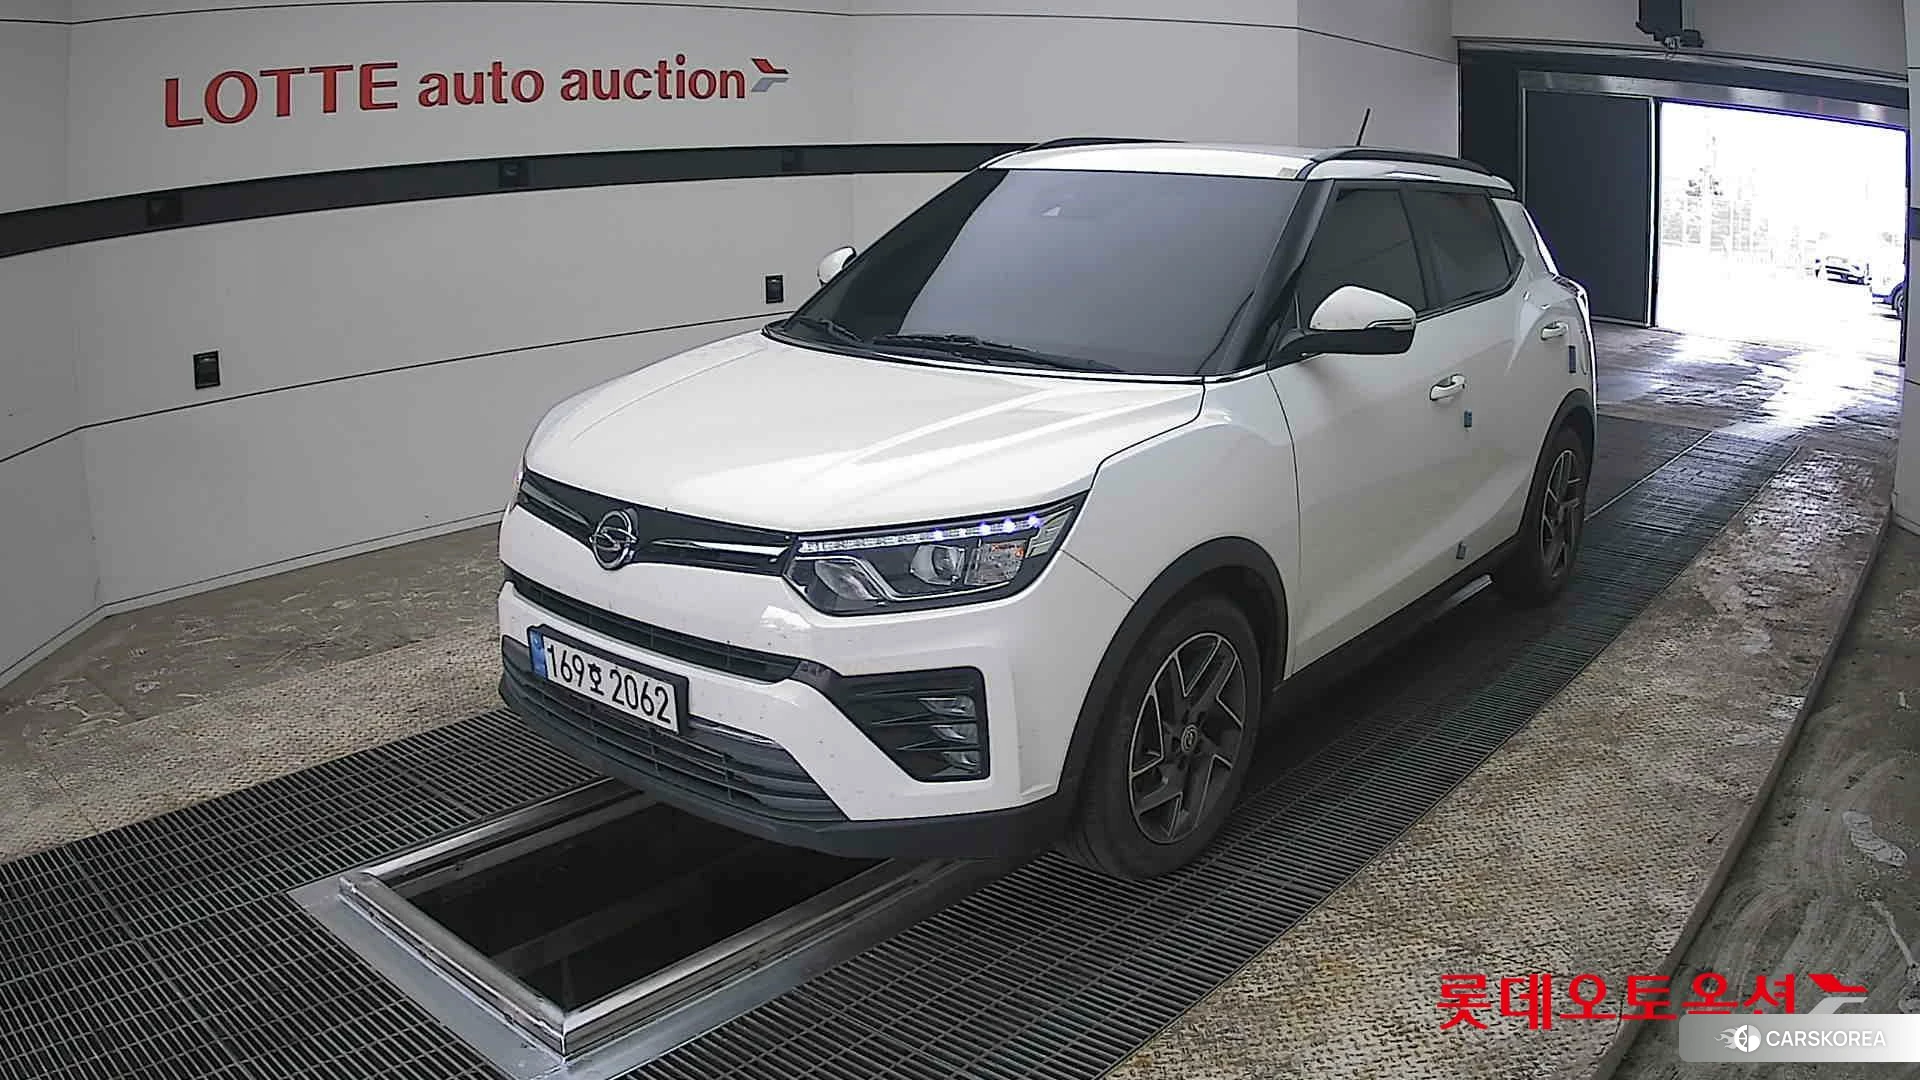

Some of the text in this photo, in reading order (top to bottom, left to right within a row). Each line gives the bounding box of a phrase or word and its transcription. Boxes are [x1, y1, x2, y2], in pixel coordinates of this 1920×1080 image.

[164, 54, 746, 127] LOTTE auto auction
[609, 668, 671, 724] 2062
